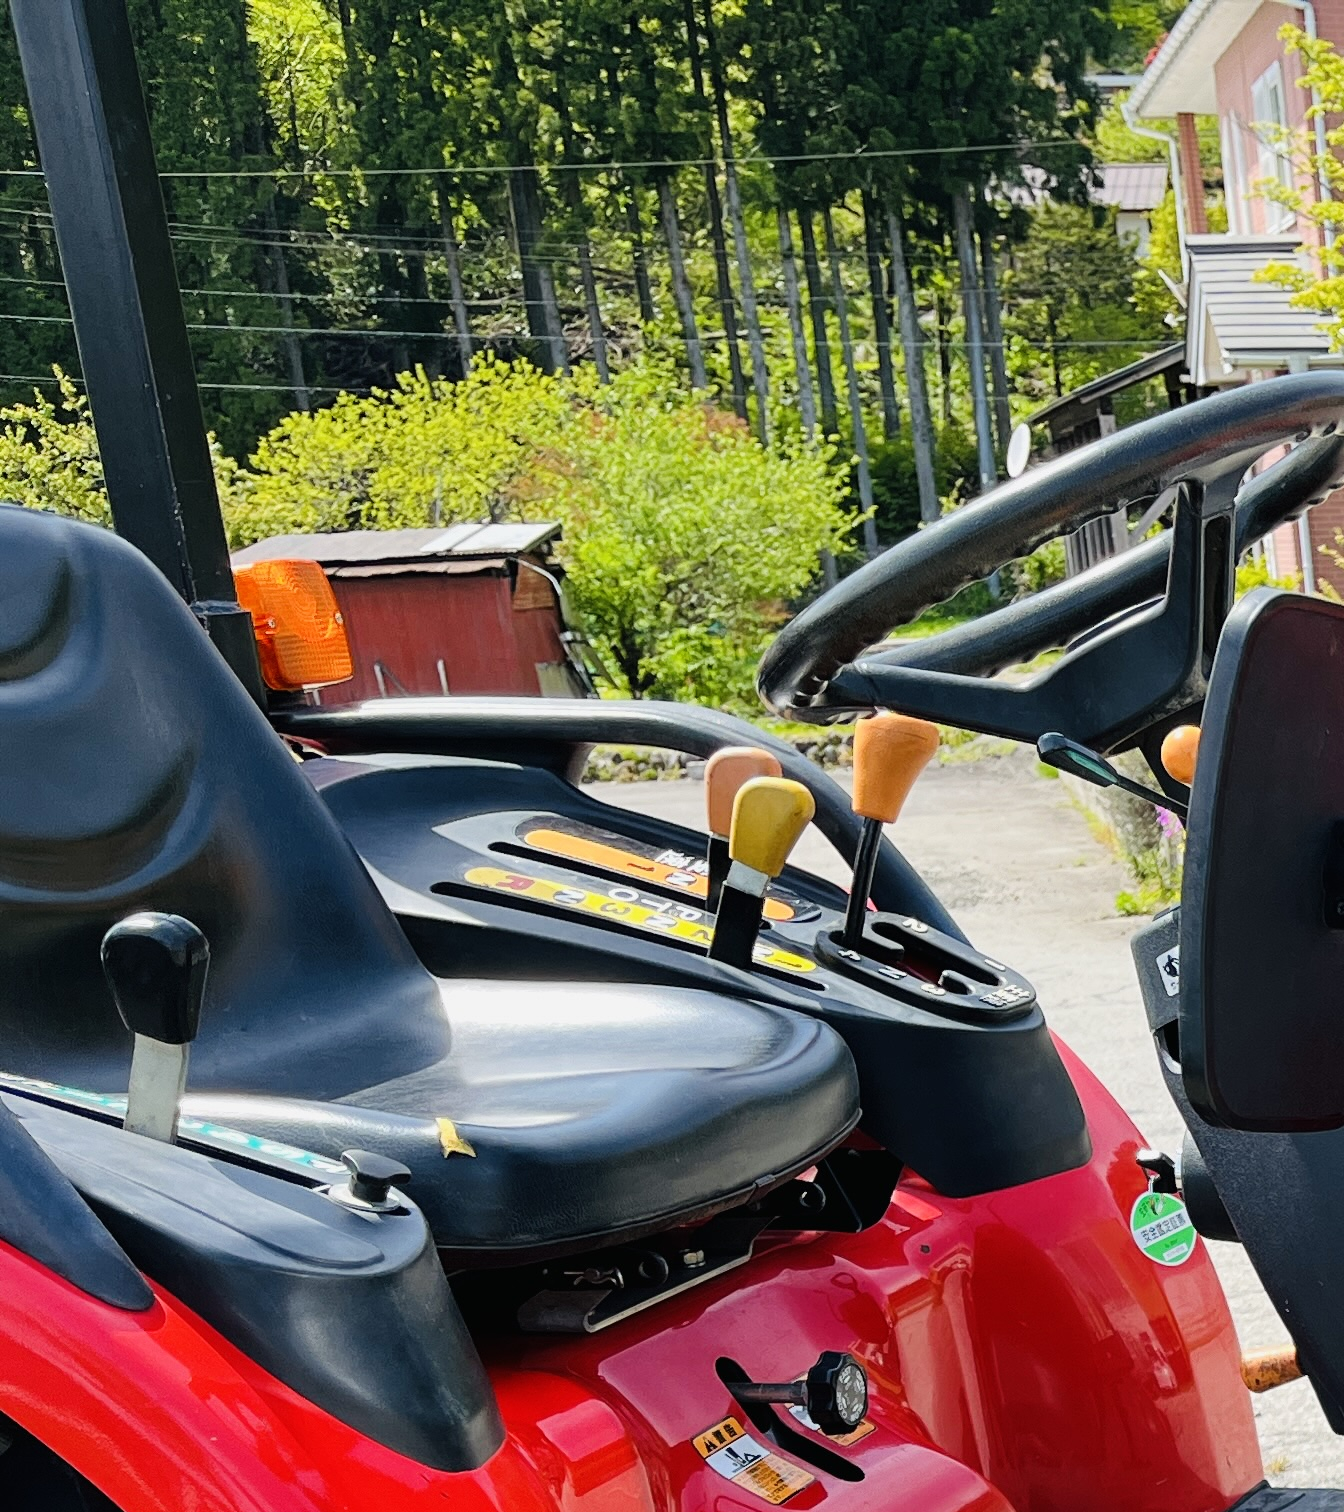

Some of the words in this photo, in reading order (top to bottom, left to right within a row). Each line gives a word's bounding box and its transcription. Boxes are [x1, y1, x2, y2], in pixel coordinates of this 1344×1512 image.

[495, 875, 535, 891] R
[608, 888, 702, 921] PTO
[878, 965, 908, 980] N
